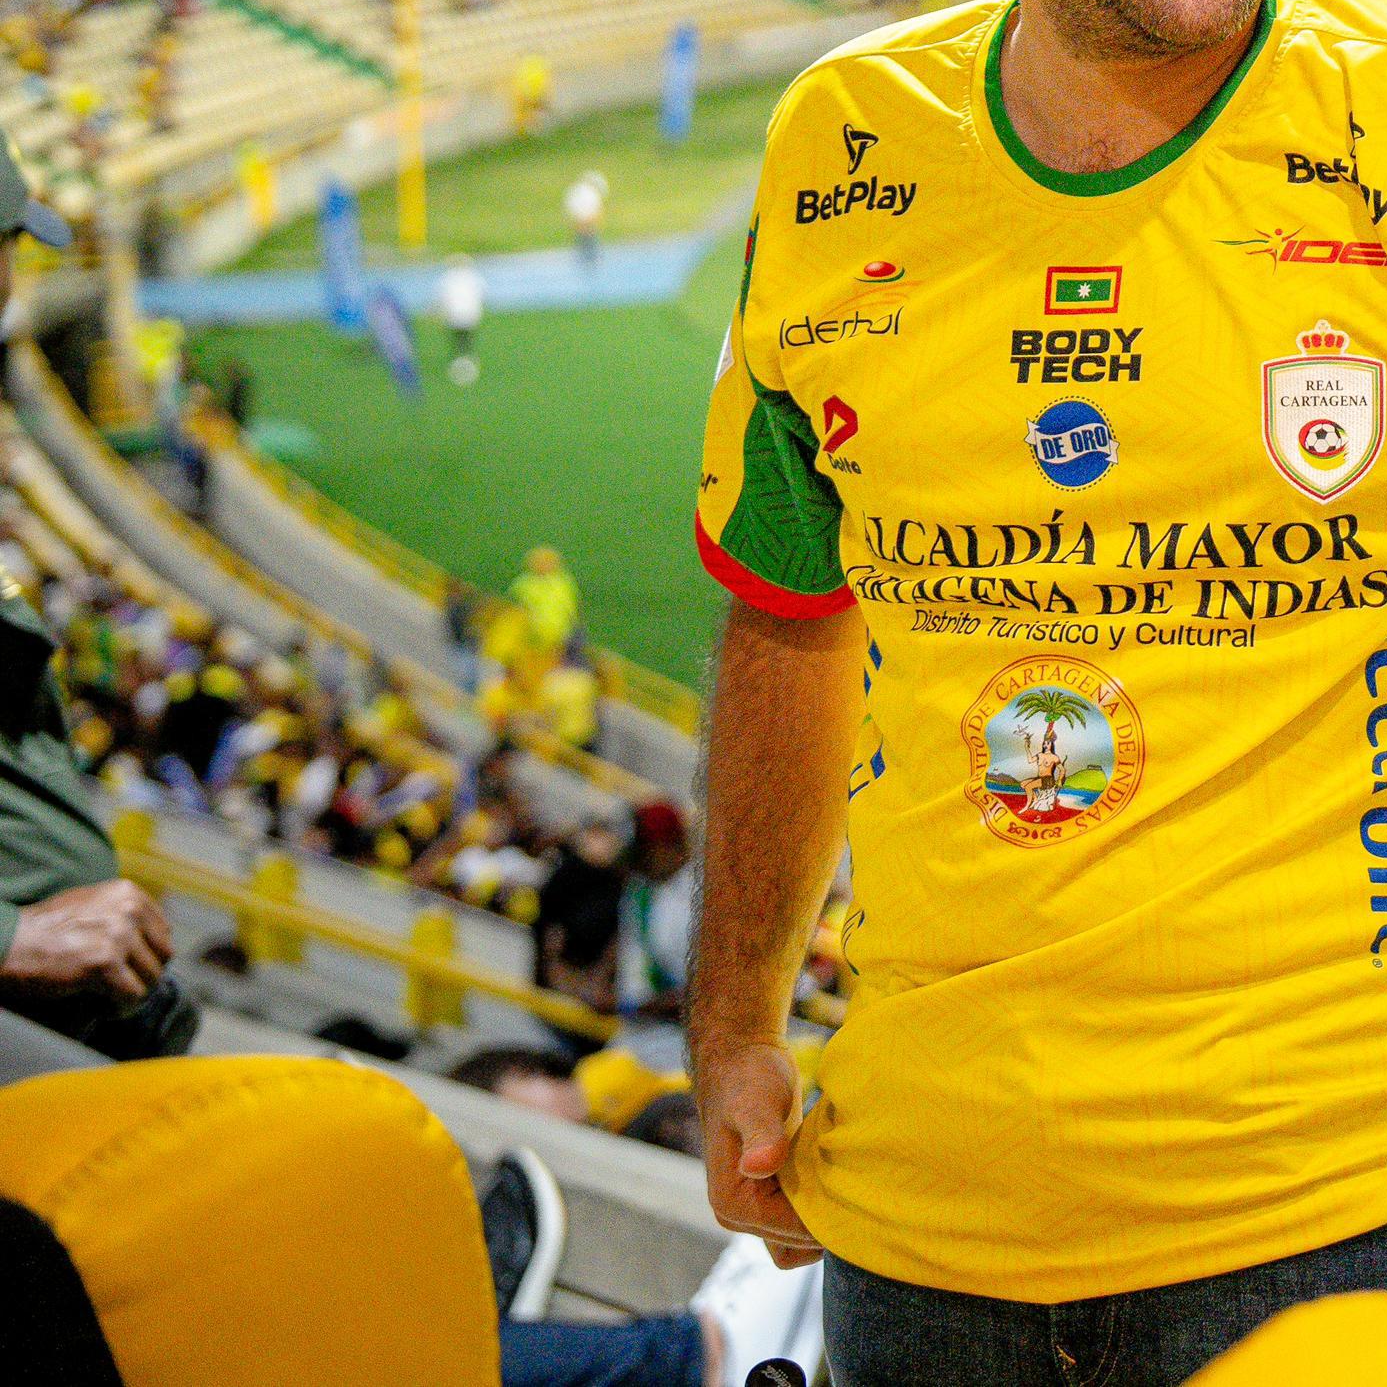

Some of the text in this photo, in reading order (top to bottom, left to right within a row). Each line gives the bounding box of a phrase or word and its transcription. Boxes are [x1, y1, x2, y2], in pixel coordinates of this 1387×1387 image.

[796, 175, 917, 224] BetPlay
[1011, 328, 1144, 355] BODY
[1010, 354, 1141, 383] TECH
[1280, 396, 1368, 407] CARTAGENA
[1306, 380, 1343, 391] REAL
[1041, 426, 1108, 459] DE ORO
[1117, 514, 1373, 570] MAYOR
[1093, 580, 1174, 615] DE
[911, 609, 981, 635] Distrito
[1109, 626, 1126, 650] y
[1136, 623, 1256, 647] Cultural
[995, 665, 1120, 718] CARTAGENA
[968, 704, 995, 732] DE
[1116, 723, 1137, 754] DE
[1075, 761, 1135, 831] INDIAS
